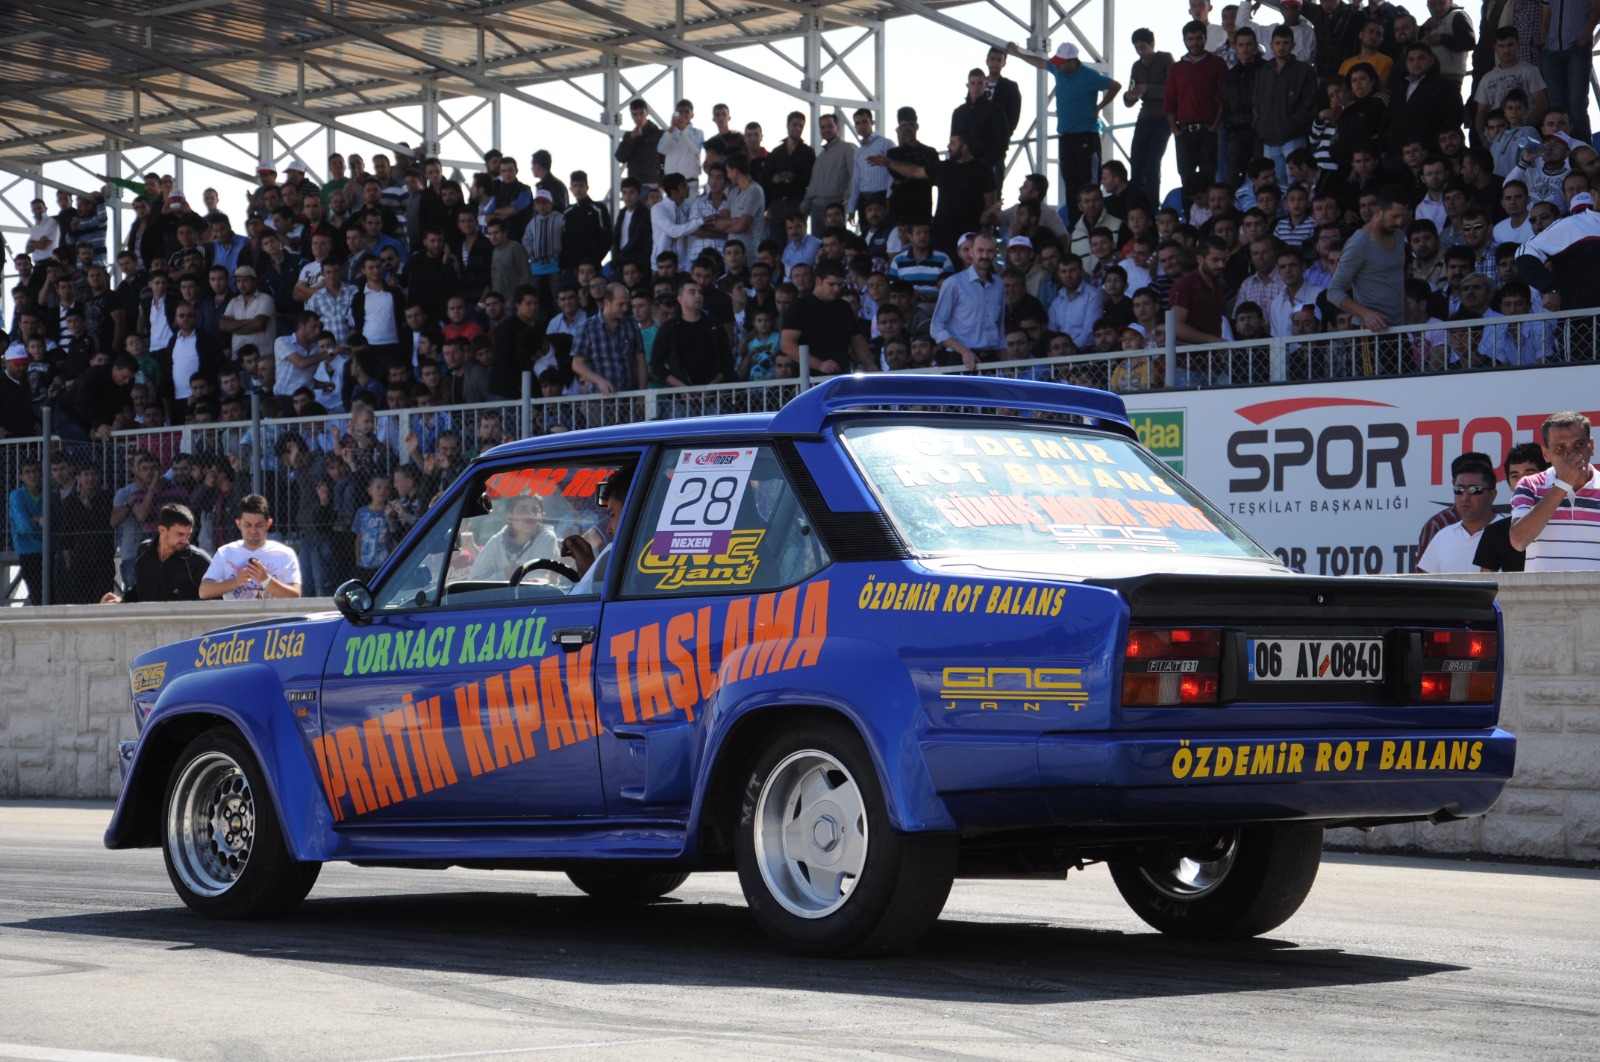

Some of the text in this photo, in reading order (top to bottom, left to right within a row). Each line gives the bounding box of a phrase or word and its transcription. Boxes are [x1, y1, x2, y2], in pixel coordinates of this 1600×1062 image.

[891, 461, 1176, 496] ROT BALANS
[670, 476, 738, 525] 28
[1034, 496, 1142, 527] MOTOR
[1127, 500, 1220, 533] SPORT
[1229, 495, 1409, 517] TEŞKİLAT BAŞKANLIĞI
[670, 537, 712, 548] NEXEN
[1316, 545, 1383, 576] TOTO
[942, 584, 984, 613] ROT
[985, 586, 1066, 616] BALANS
[195, 629, 305, 668] Serdar Usta
[343, 626, 456, 676] TORNACI
[1255, 642, 1282, 678] 06
[1296, 642, 1321, 678] AY
[1330, 642, 1380, 678] 0840
[454, 643, 604, 778] KAPAK
[610, 579, 830, 724] TAŞLAMA
[942, 667, 1082, 689] GNC
[1150, 661, 1198, 671] FIAT 131
[1448, 661, 1473, 671] BRAVA
[290, 691, 313, 701] FIAT
[945, 702, 1086, 711] JANT
[1315, 741, 1369, 772] ROT
[1379, 740, 1483, 772] BALANS
